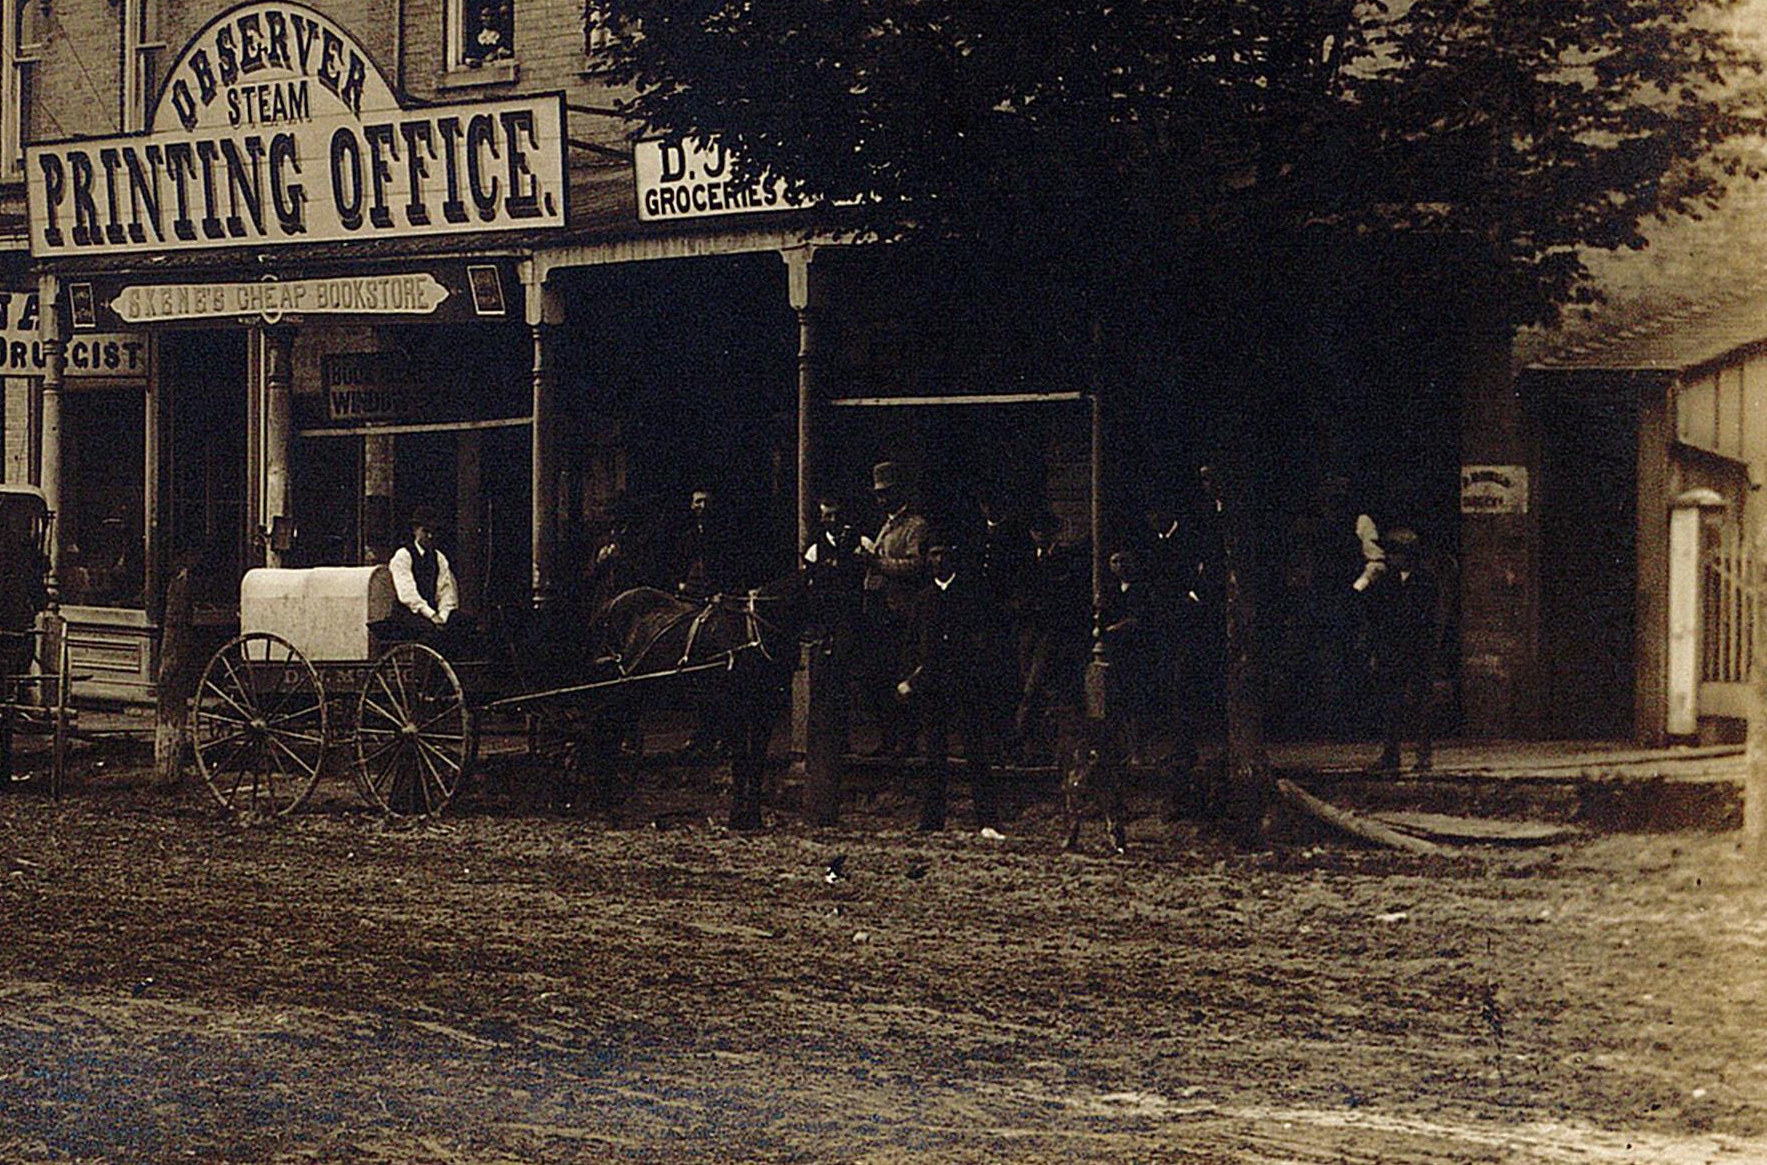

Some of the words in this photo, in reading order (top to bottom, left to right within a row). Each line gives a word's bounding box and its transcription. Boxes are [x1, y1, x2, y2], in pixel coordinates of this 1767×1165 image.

[170, 10, 366, 132] OBSERVER
[227, 80, 312, 127] STEAM
[39, 133, 307, 247] PRINTING
[332, 110, 557, 233] OFFICE.
[644, 181, 778, 217] GROCERIES
[128, 286, 225, 320] SKENE'S
[237, 284, 307, 312] CHEAP
[318, 276, 429, 311] BOOKSTORE
